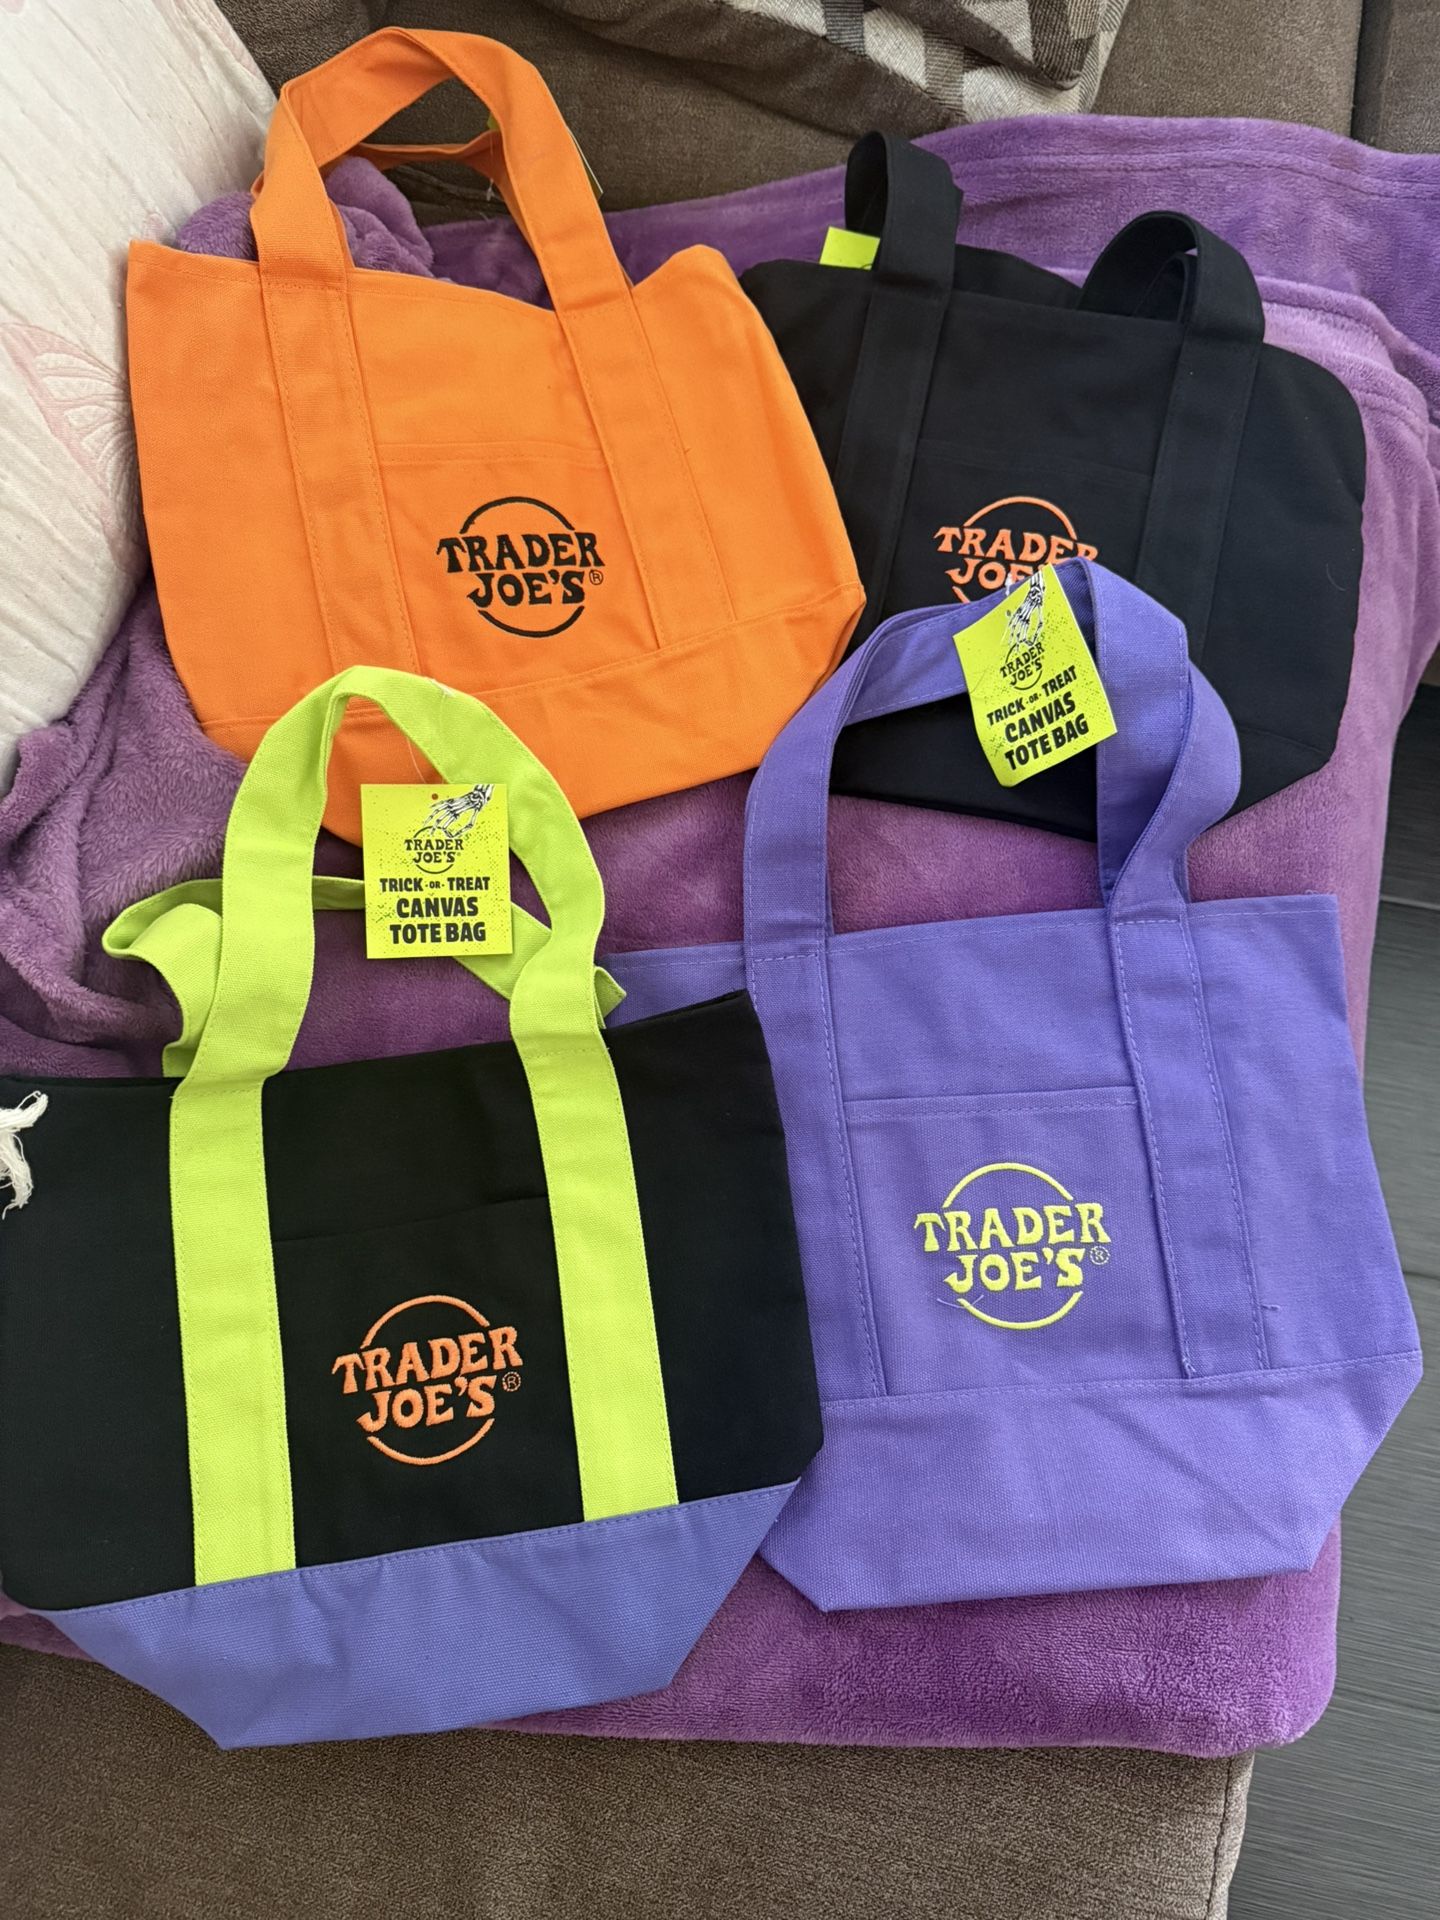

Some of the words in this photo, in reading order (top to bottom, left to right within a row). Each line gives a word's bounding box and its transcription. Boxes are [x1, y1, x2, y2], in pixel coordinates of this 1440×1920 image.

[436, 532, 606, 573] TRADER
[467, 569, 585, 608] JOE'S
[1000, 642, 1045, 678] TRADER
[1010, 658, 1043, 686] JOE'S
[986, 697, 1026, 726] TRICK
[1042, 665, 1078, 698] TREAT
[1004, 691, 1076, 743] CANVAS
[1004, 733, 1053, 770] TOTE
[1053, 713, 1089, 749] BAG
[404, 838, 464, 851] TRADER
[413, 851, 456, 863] JOE'S
[380, 877, 423, 892] TRICK
[447, 877, 490, 891] TREAT
[396, 896, 479, 918] CANVAS
[389, 923, 442, 944] TOTE
[445, 921, 486, 942] BAG
[913, 1202, 1111, 1252] TRADER
[943, 1247, 1086, 1293] JOE'S
[331, 1326, 523, 1394] TRADER
[356, 1375, 497, 1432] JOE'S
